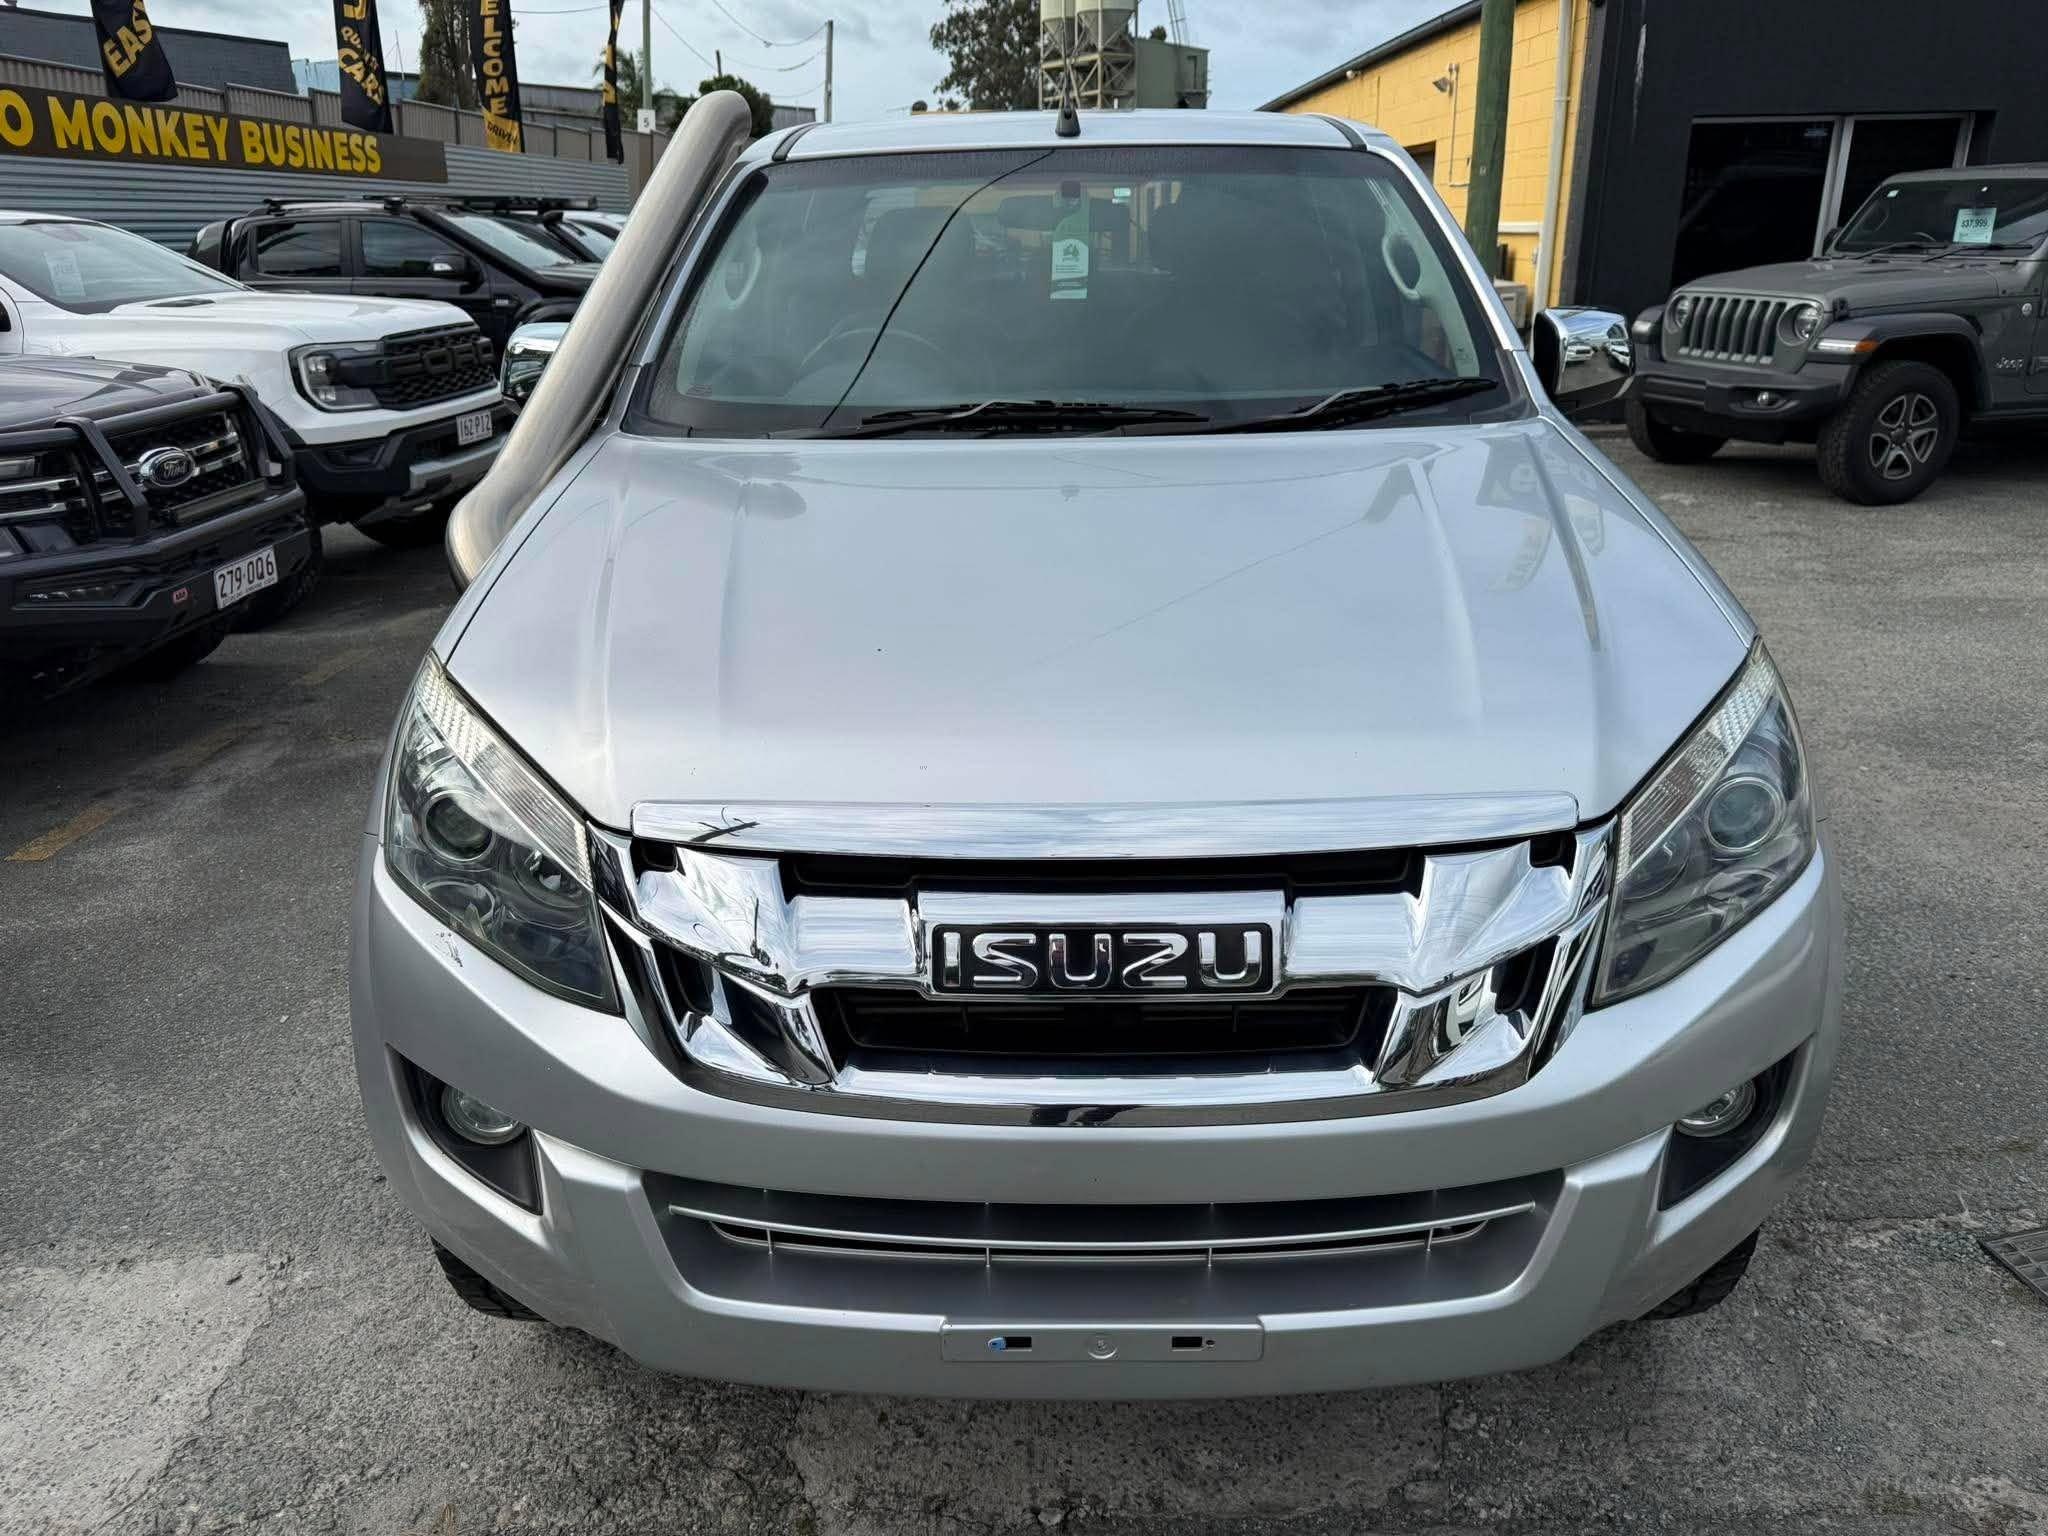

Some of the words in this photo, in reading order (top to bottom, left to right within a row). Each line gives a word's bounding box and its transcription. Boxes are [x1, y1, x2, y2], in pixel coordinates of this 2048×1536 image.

[47, 95, 229, 161] MONKEY
[239, 119, 382, 174] BUSINESS
[943, 931, 1263, 989] ISUZU
